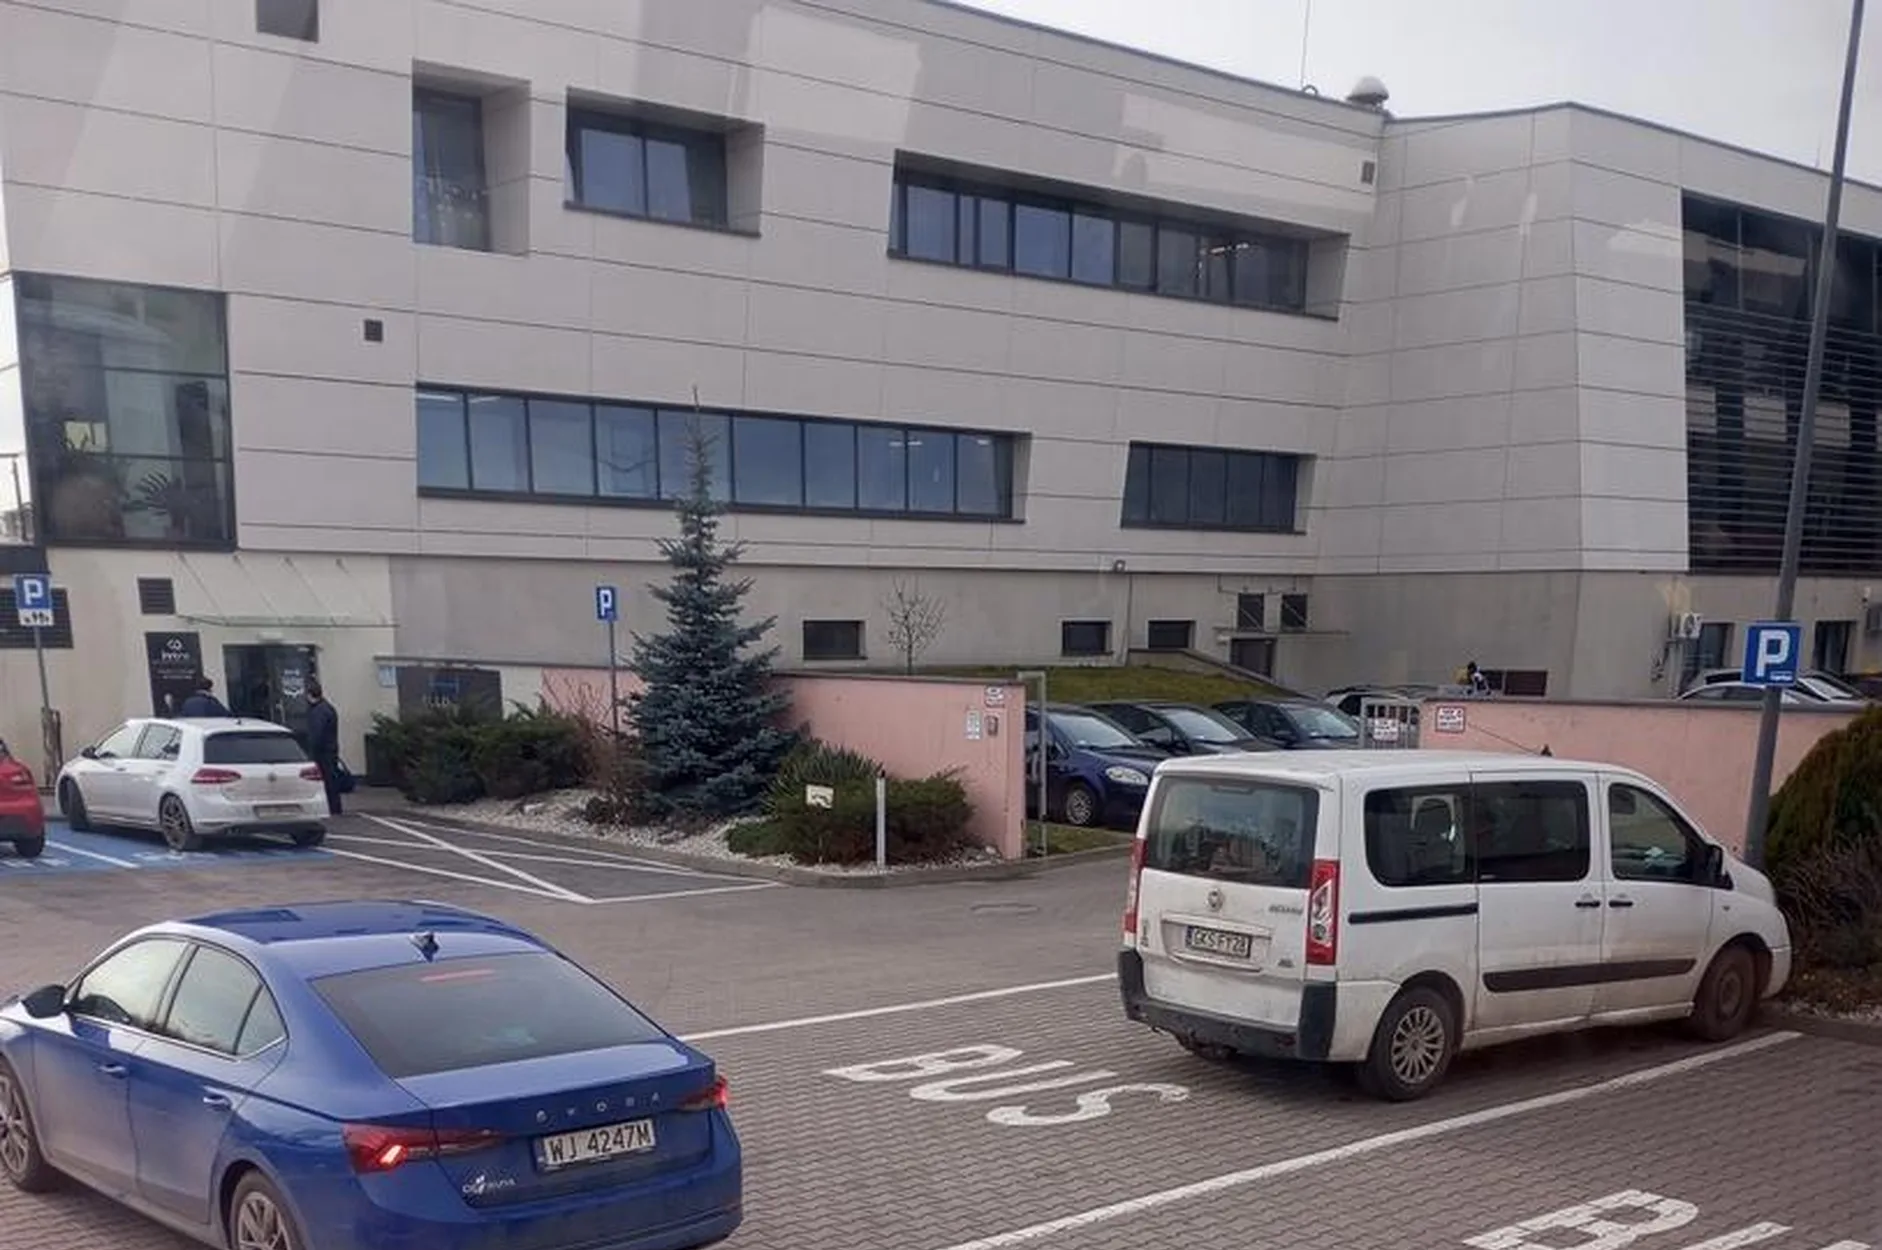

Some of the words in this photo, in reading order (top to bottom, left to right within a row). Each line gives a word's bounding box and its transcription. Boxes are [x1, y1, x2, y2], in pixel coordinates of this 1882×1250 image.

[23, 579, 43, 605] P
[600, 589, 612, 617] P
[1756, 629, 1790, 677] P
[823, 1044, 1190, 1126] BUS
[549, 1137, 577, 1162] WJ
[587, 1122, 651, 1154] 4247M
